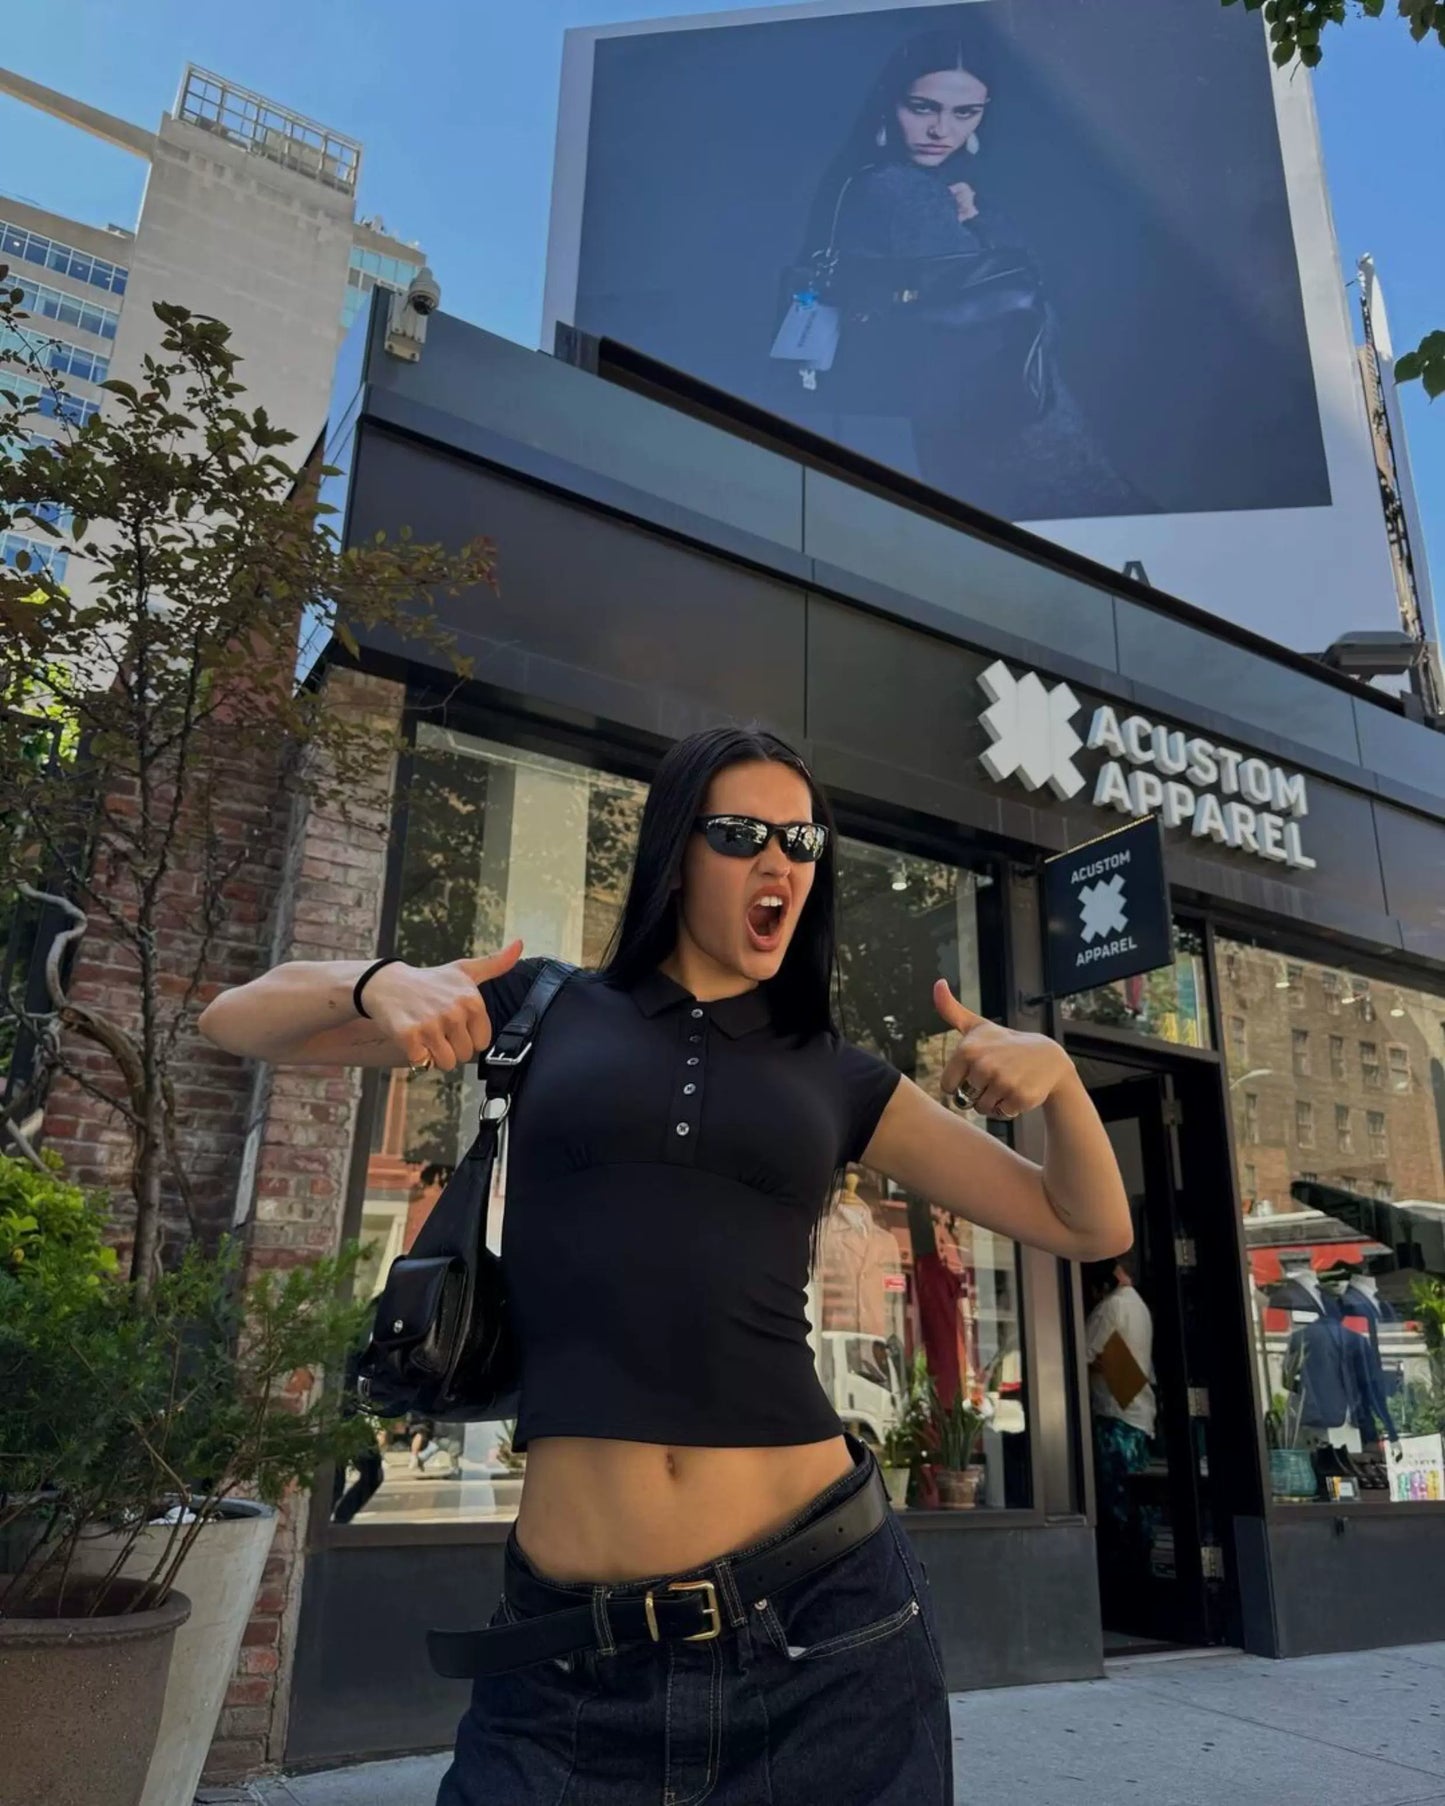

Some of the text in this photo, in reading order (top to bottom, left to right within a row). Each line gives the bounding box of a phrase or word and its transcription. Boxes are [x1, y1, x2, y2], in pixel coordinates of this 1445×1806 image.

[1087, 705, 1308, 817] ACUSTOM
[1093, 761, 1316, 869] APPAREL
[1071, 849, 1131, 884] ACUSTOM
[1076, 936, 1138, 967] APPAREL
